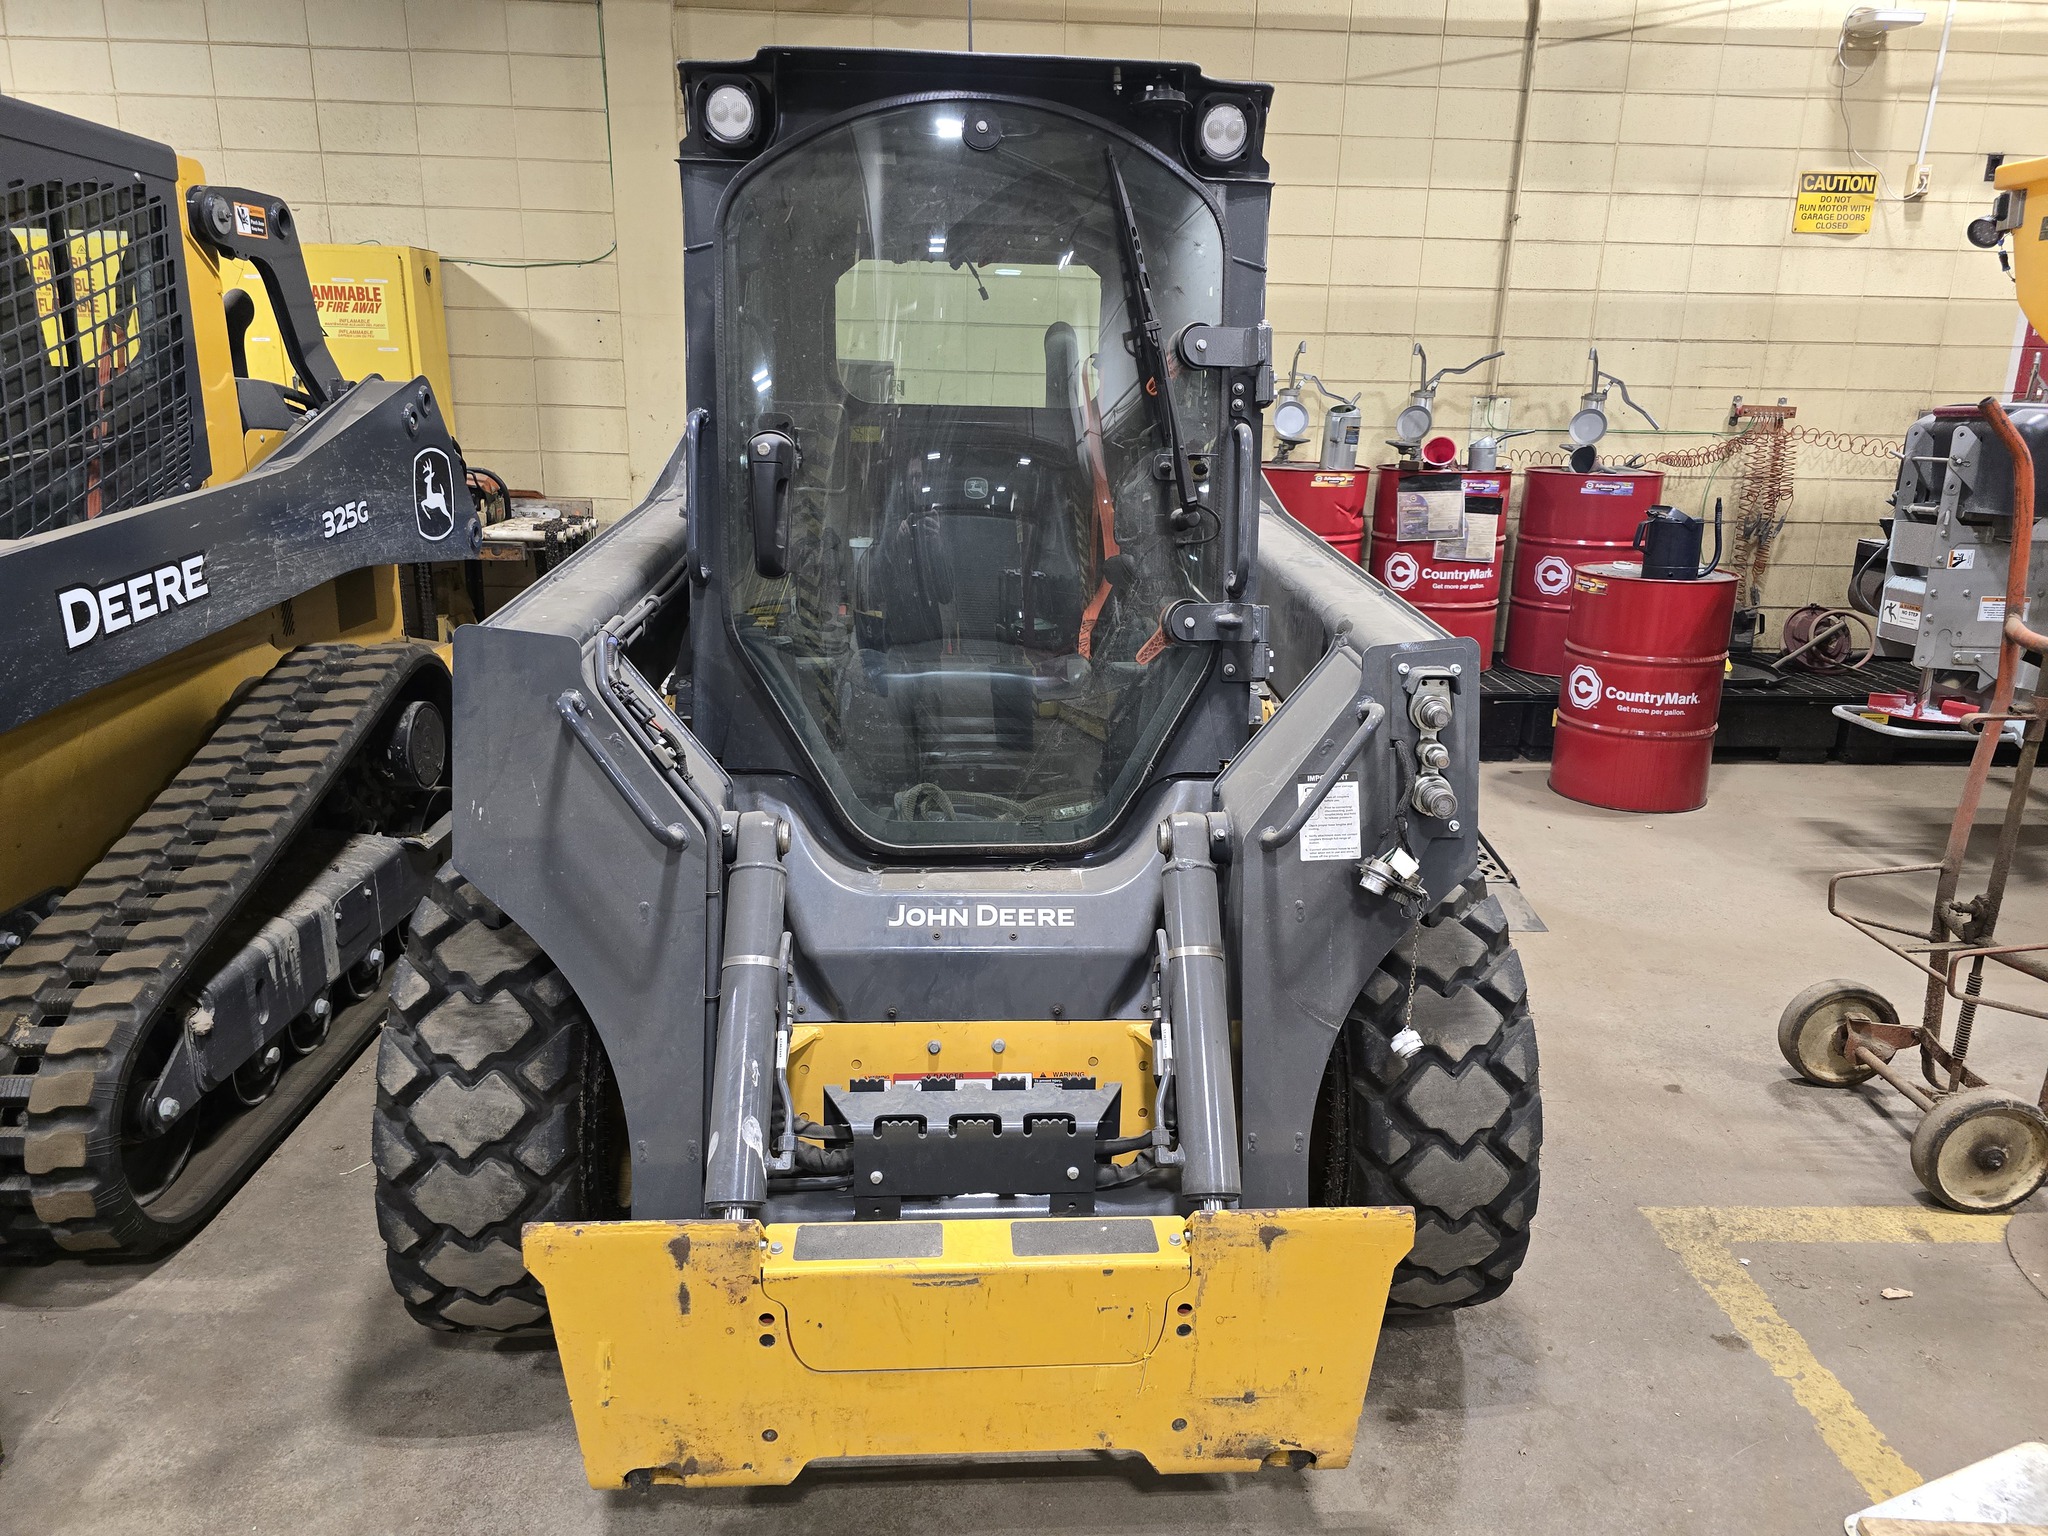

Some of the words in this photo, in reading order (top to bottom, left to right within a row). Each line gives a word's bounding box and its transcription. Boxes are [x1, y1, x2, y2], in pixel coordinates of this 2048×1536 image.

[1803, 175, 1875, 191] CAUTION
[1820, 195, 1832, 203] DO
[1818, 204, 1848, 212] MOTOR
[1836, 213, 1866, 221] DOORS
[312, 285, 382, 302] AMMABLE
[326, 302, 350, 312] FIRE
[351, 303, 382, 314] AWAY
[322, 501, 369, 538] 325G
[59, 555, 209, 649] DEERE
[1616, 704, 1630, 712] Get
[888, 904, 969, 927] JOHN
[976, 904, 1075, 927] DEERE
